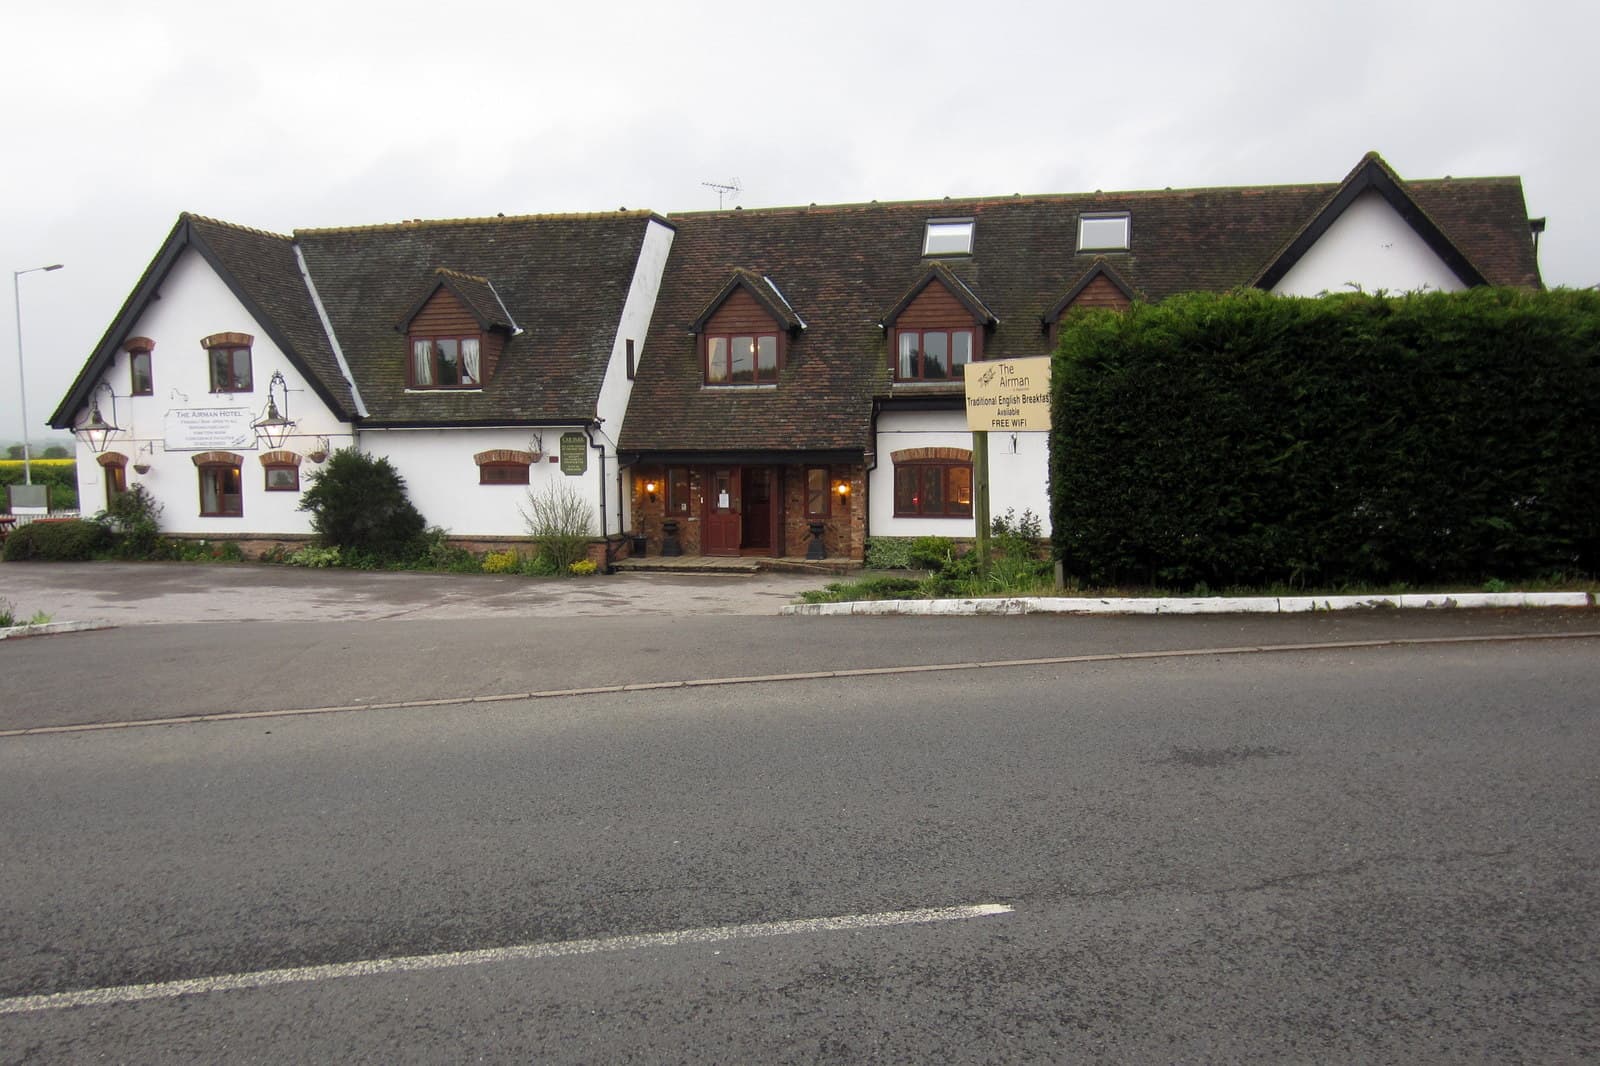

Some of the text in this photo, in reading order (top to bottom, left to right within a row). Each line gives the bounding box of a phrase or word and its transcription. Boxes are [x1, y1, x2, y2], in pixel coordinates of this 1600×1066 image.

[999, 364, 1014, 375] The
[1000, 376, 1030, 388] Airman
[968, 396, 997, 407] Traditional
[998, 395, 1021, 407] English
[176, 411, 190, 419] THE
[192, 410, 218, 418] AIRMAN
[997, 407, 1020, 416] Available
[992, 418, 1027, 428] FREE WIFI
